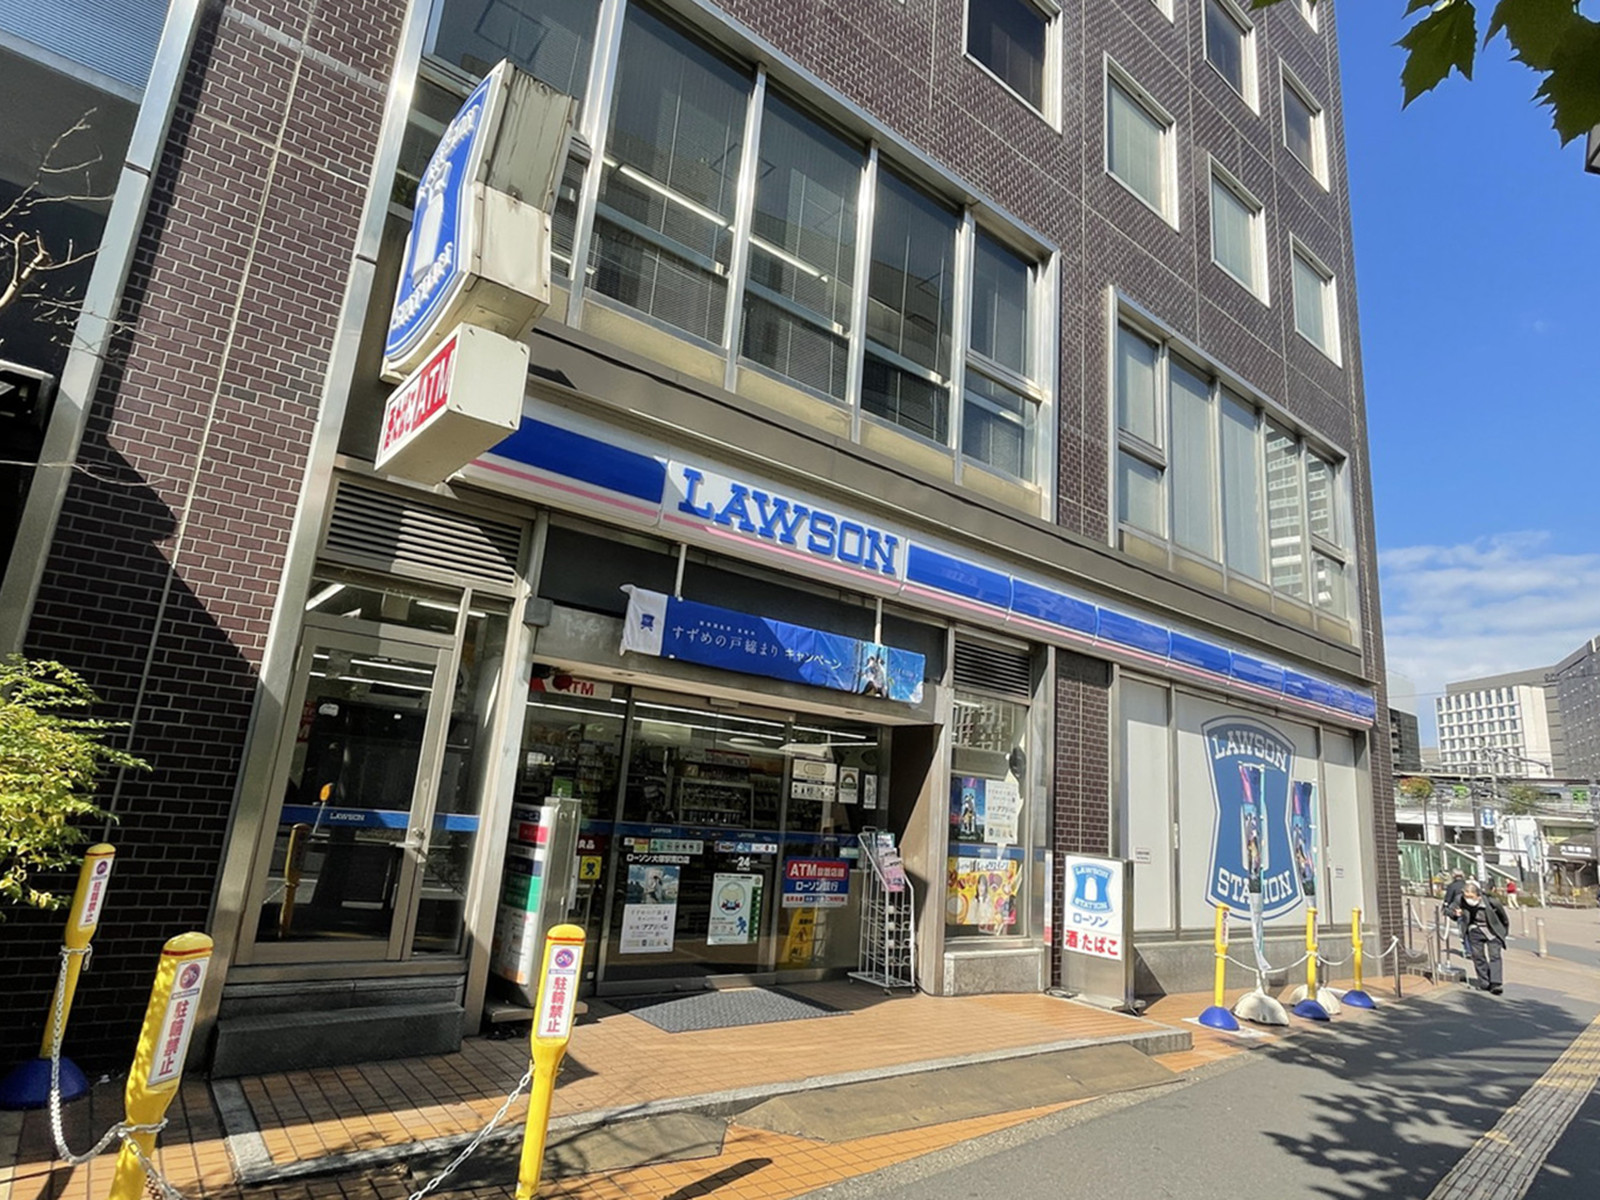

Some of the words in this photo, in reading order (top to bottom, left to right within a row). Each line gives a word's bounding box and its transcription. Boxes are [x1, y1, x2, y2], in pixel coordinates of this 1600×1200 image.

[678, 468, 899, 575] LAWSON
[785, 647, 843, 670] キャンペーン
[1211, 730, 1288, 774] LAWSON
[329, 811, 365, 822] LAWSON
[1217, 867, 1294, 905] STAION
[1073, 912, 1109, 928] ローソン
[546, 976, 568, 1033] 駐輪禁止
[158, 999, 190, 1078] 駐輪禁止
